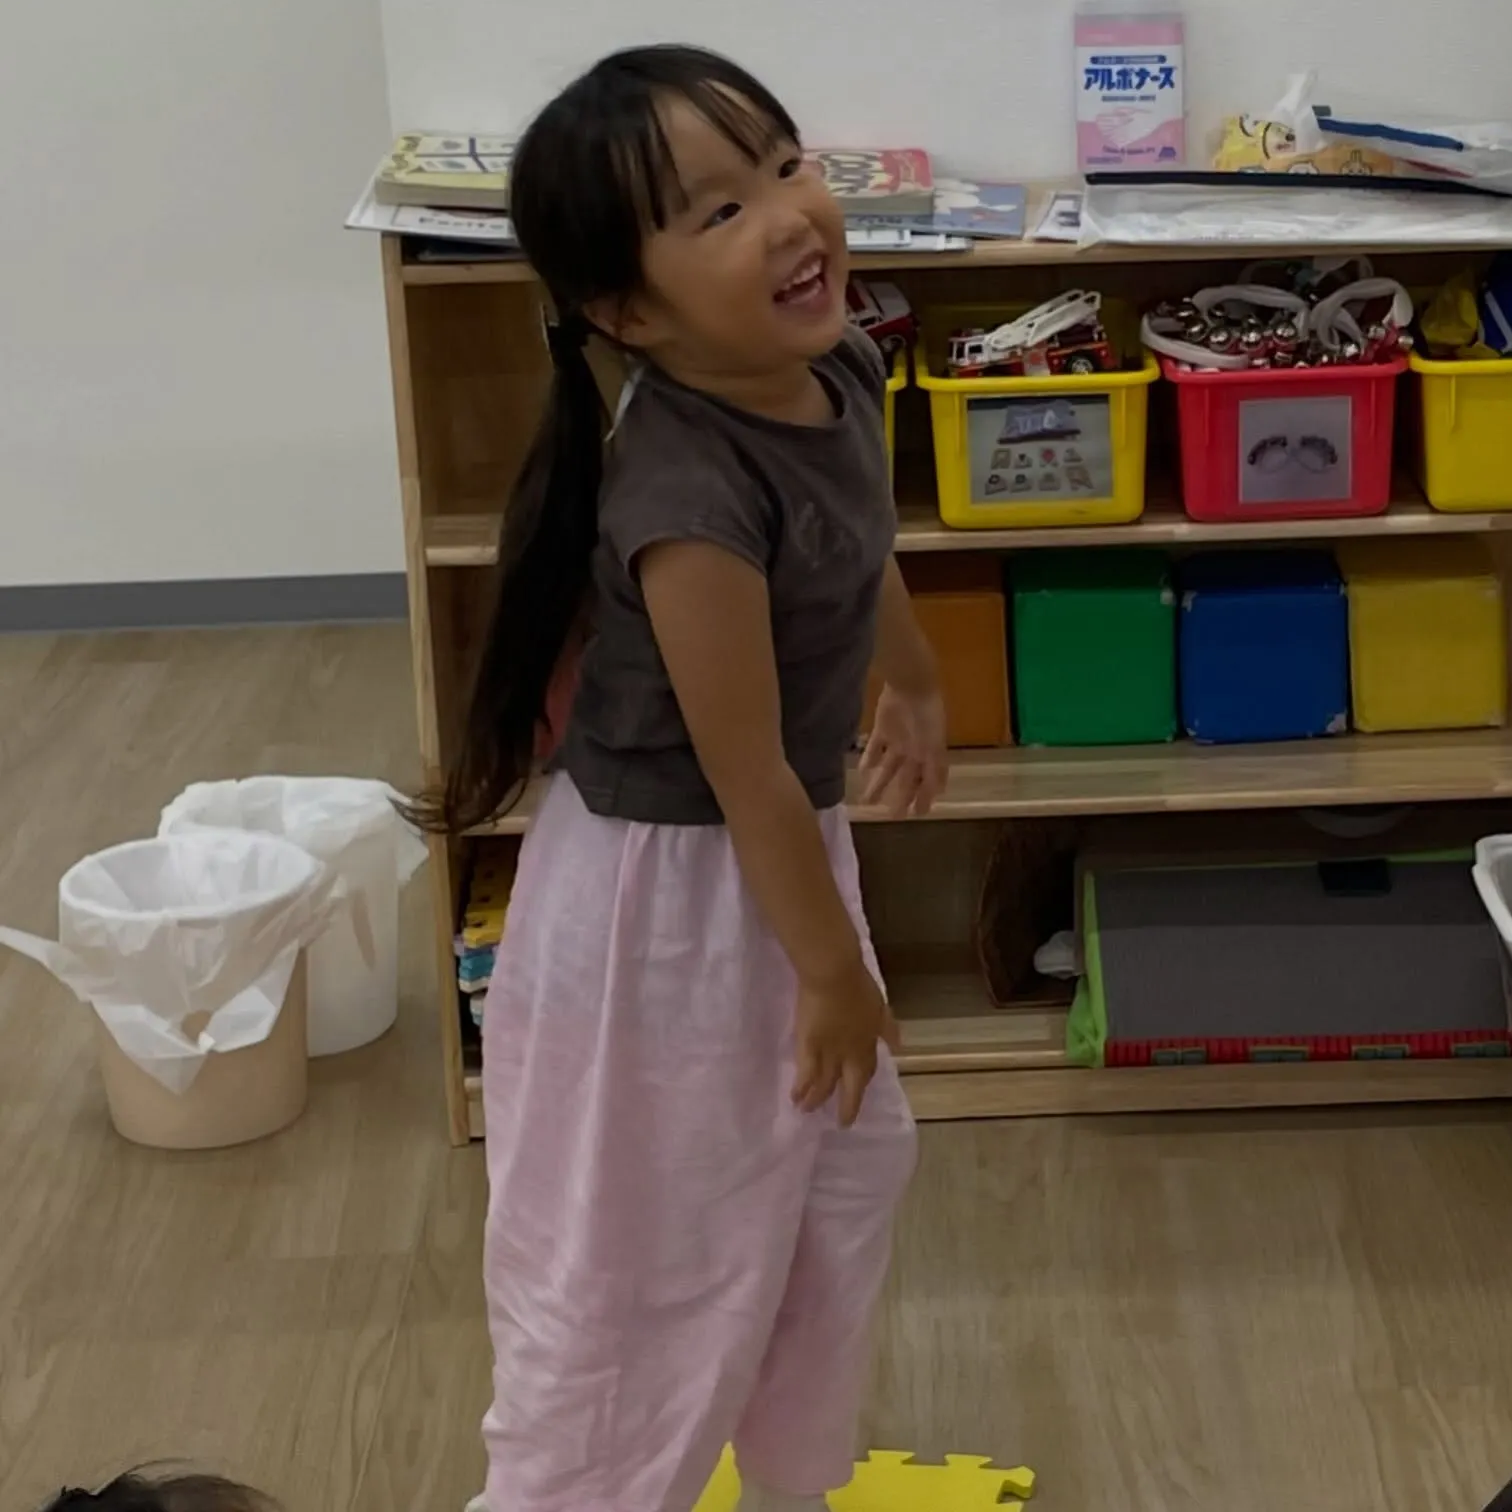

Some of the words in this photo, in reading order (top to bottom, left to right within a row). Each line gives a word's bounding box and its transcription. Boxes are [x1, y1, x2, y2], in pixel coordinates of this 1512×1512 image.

[1084, 65, 1176, 91] アルボナース
